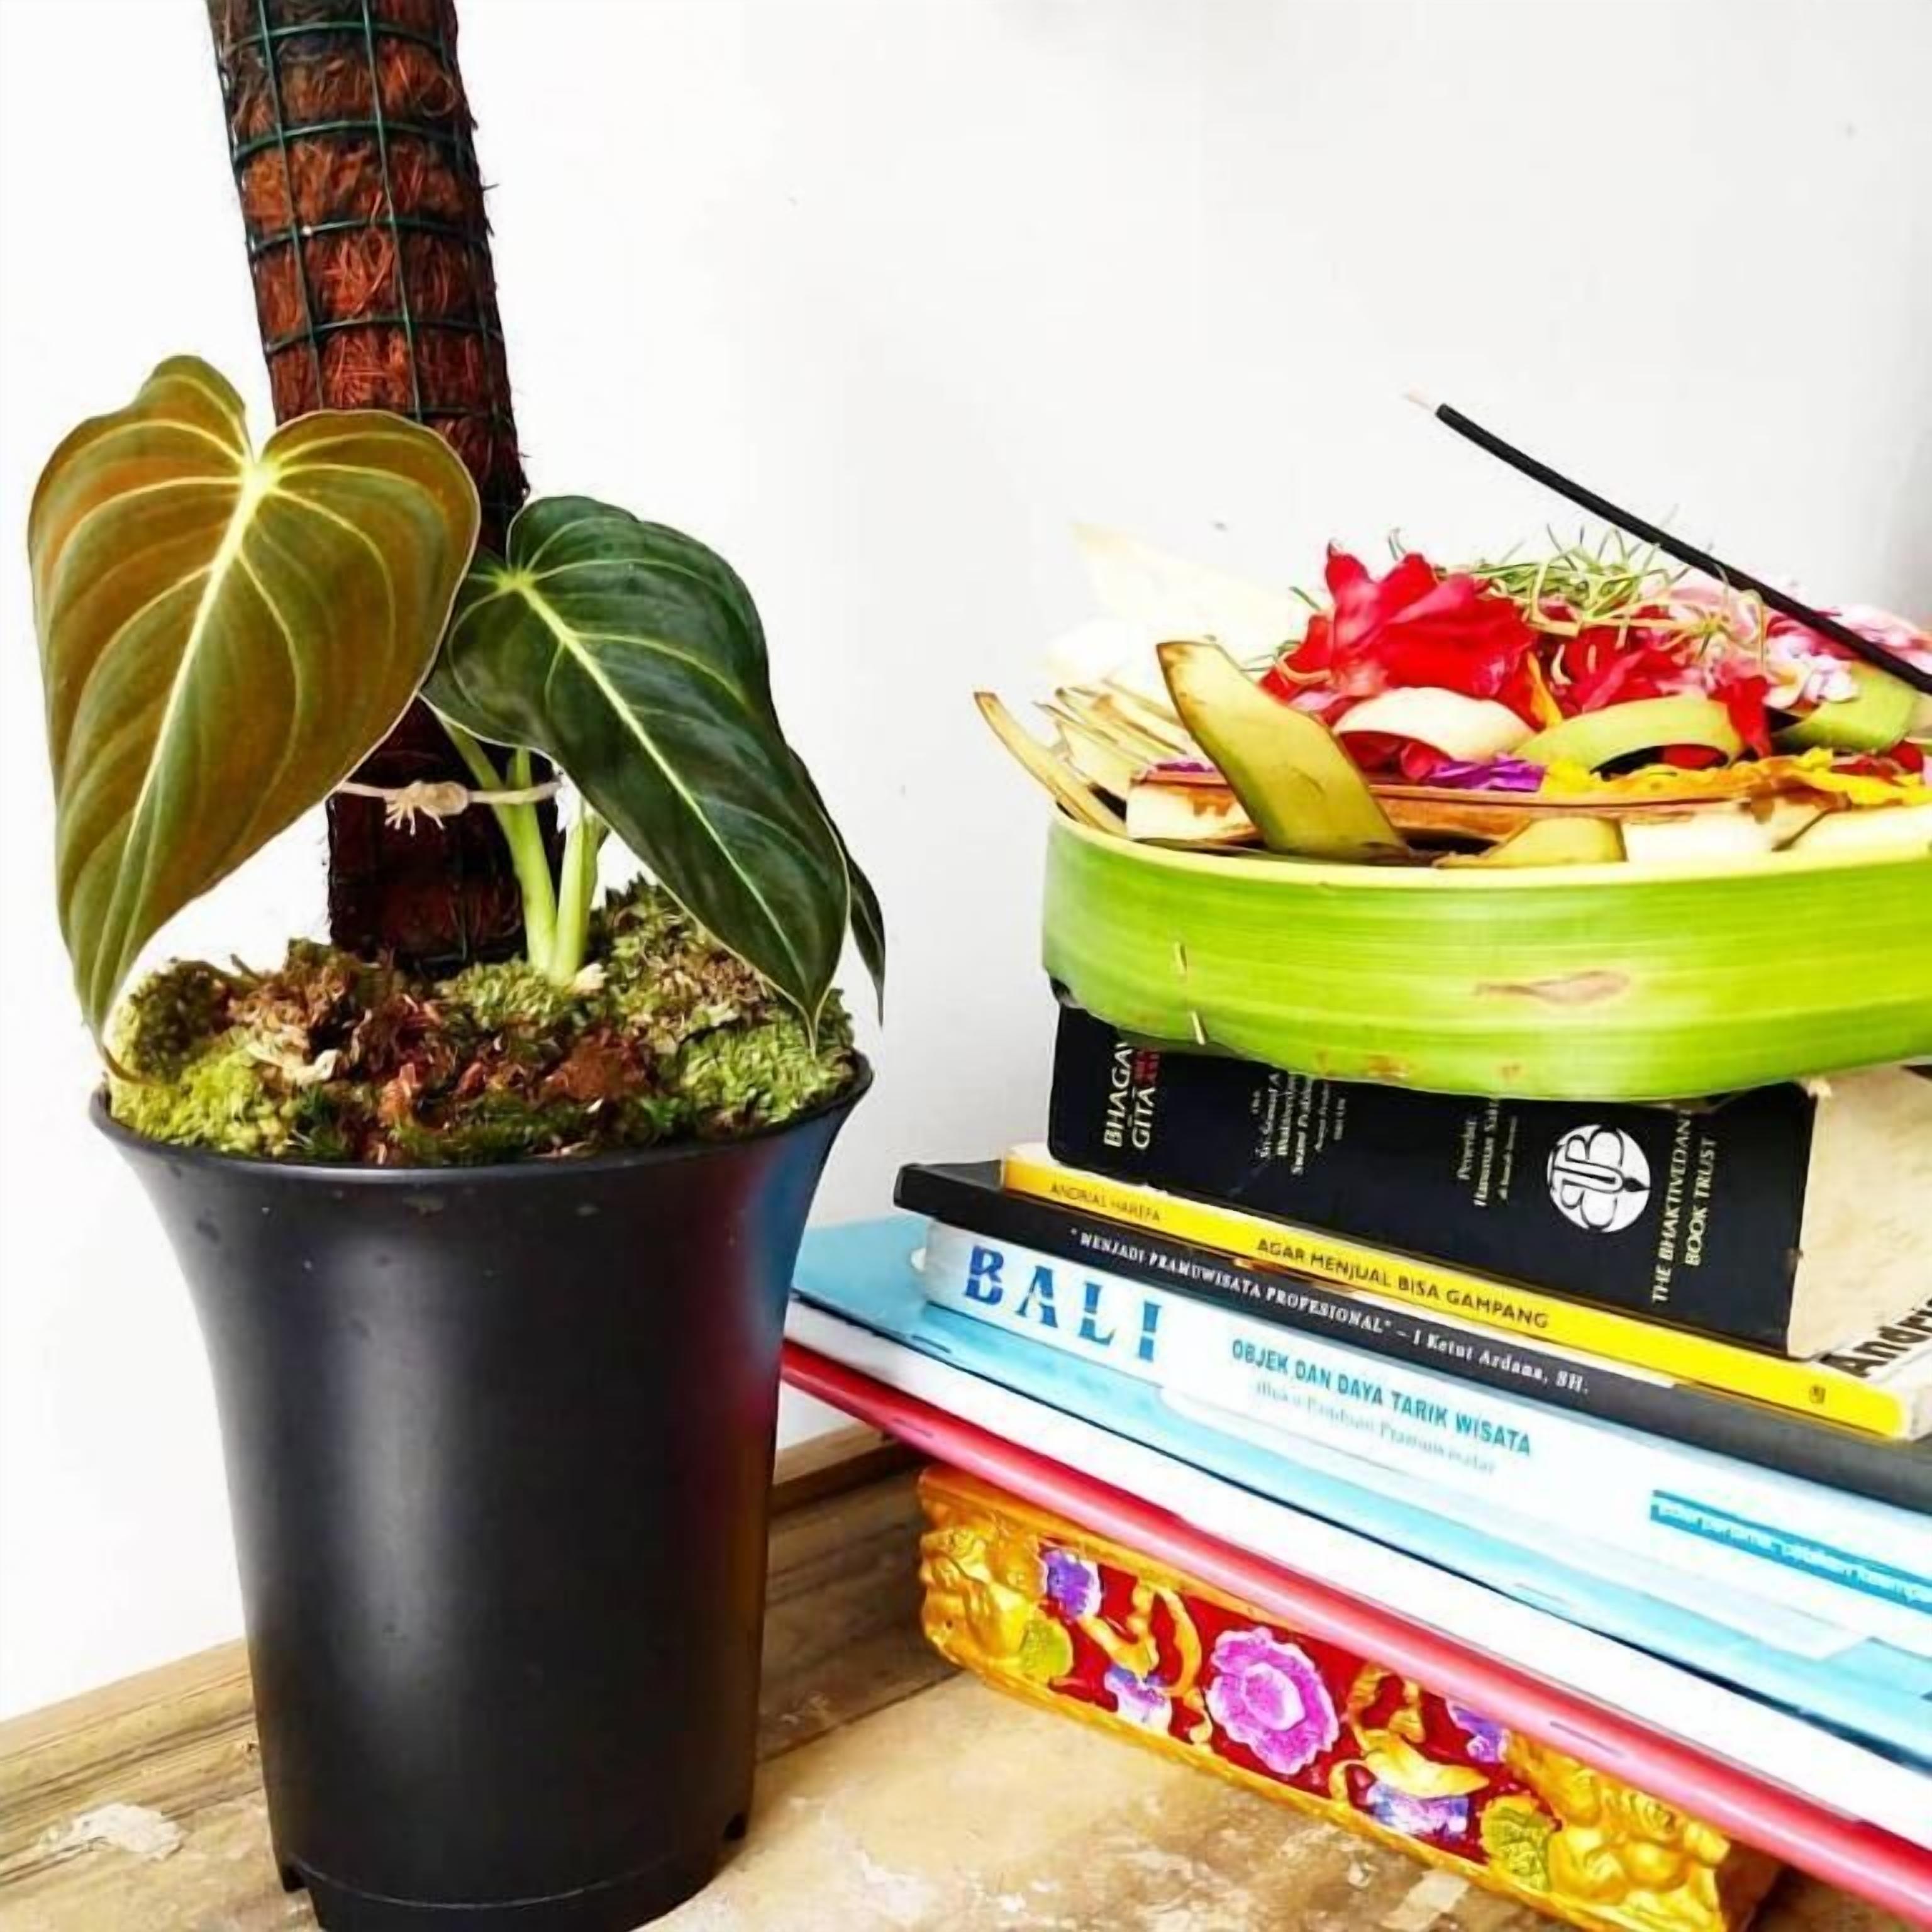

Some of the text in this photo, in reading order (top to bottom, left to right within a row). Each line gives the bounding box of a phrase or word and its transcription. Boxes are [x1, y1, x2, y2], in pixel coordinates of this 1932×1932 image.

[1685, 1137, 1717, 1266] BOOK TRUST
[963, 1244, 1162, 1363] BALI
[1148, 1248, 1261, 1298] PRAMUWISATA
[1257, 1237, 1550, 1329] AGAR MENJUAL BISA GAMPANG
[1652, 1263, 1672, 1302] THE
[1232, 1338, 1531, 1457] OBJEK DAN DAYA TARIK WISATA
